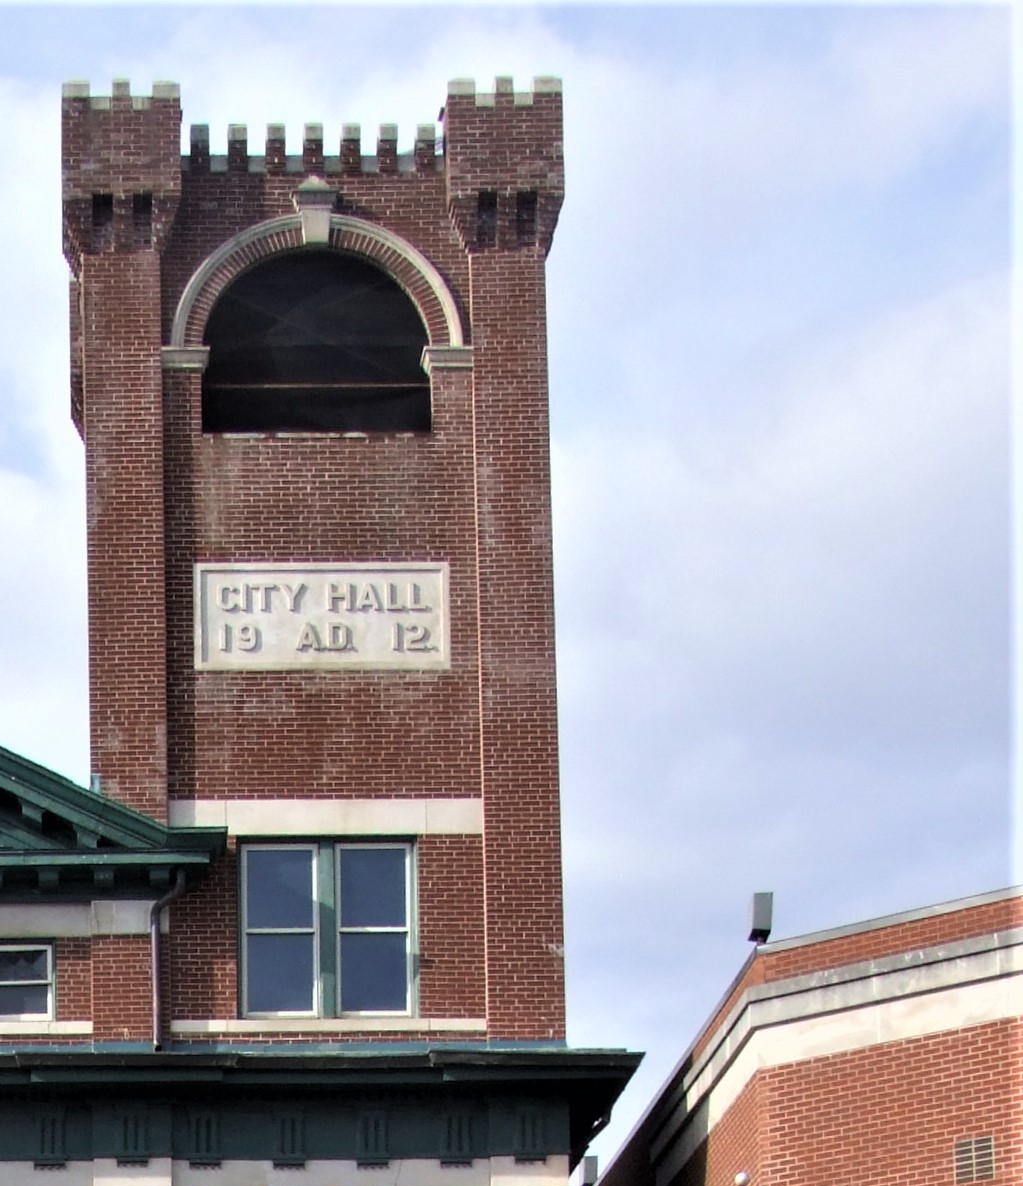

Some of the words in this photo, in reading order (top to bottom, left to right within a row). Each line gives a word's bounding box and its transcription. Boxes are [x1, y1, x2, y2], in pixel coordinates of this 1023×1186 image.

[216, 582, 308, 613] CITY
[326, 582, 431, 613] HALL
[219, 622, 262, 652] 19
